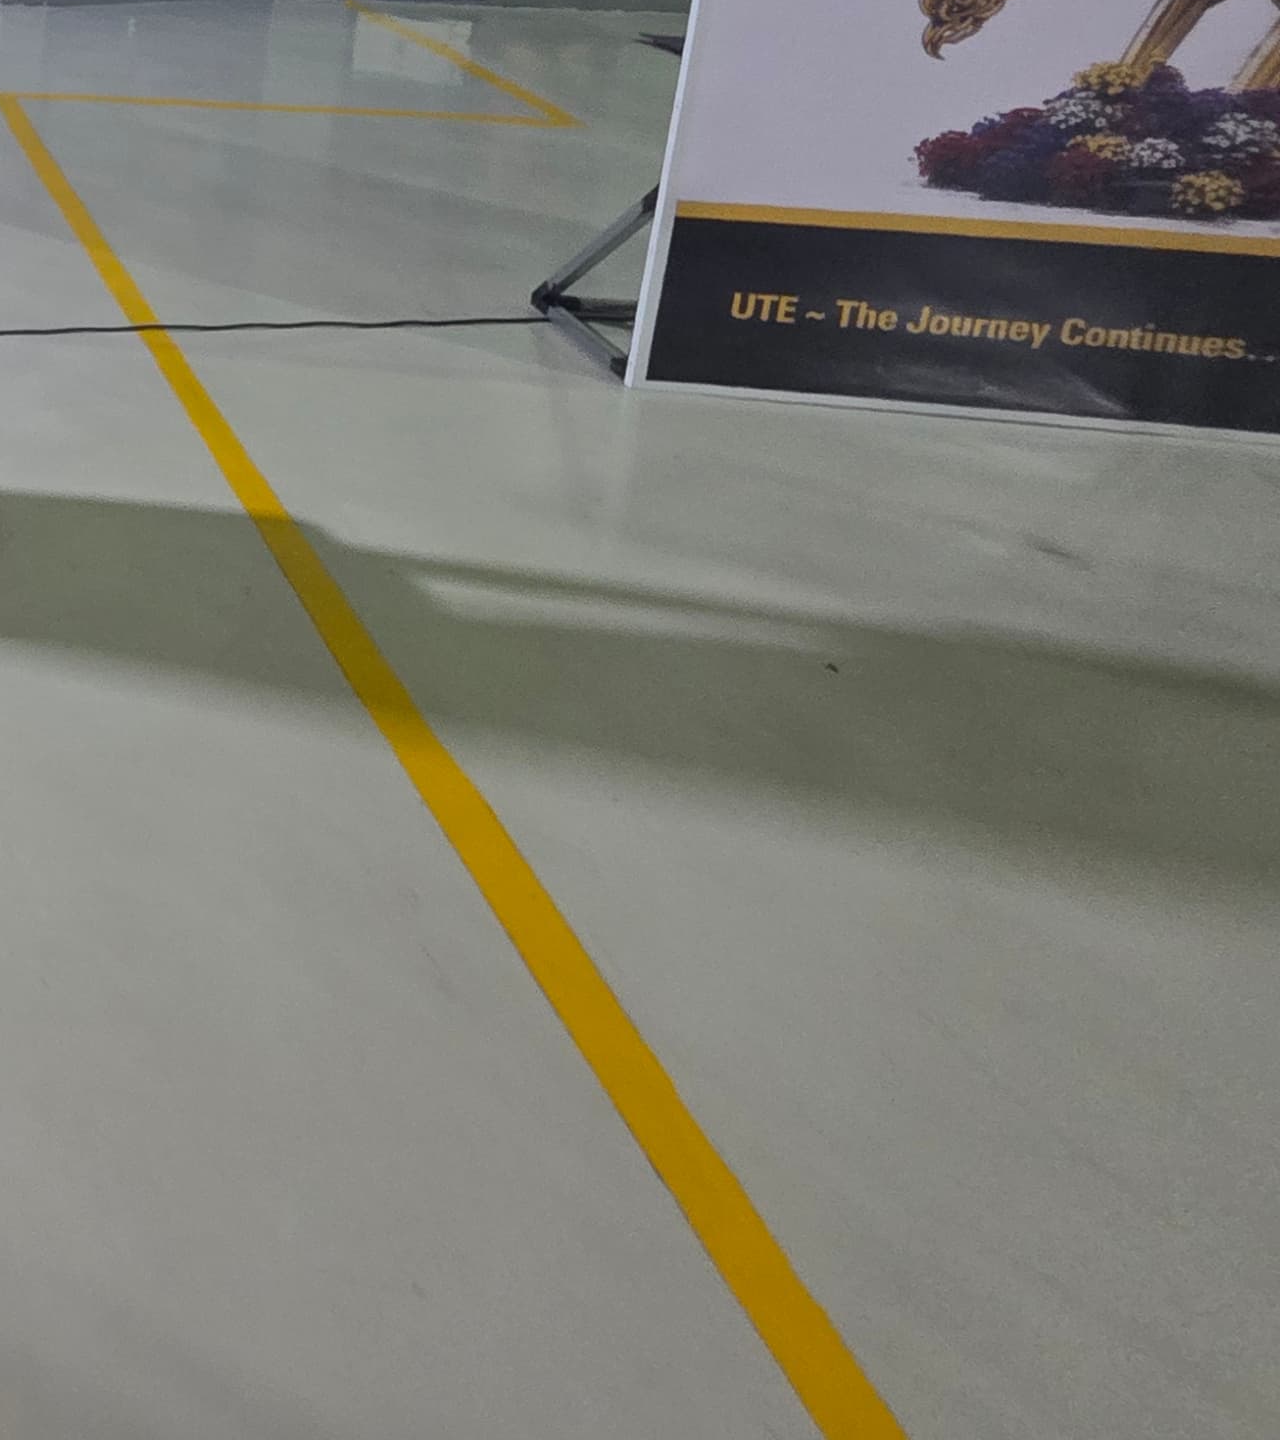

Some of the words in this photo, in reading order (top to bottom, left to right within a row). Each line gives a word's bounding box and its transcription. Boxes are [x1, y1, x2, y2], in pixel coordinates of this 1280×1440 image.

[730, 291, 799, 324] UTE
[836, 298, 898, 332] The
[906, 305, 1049, 348] Journey
